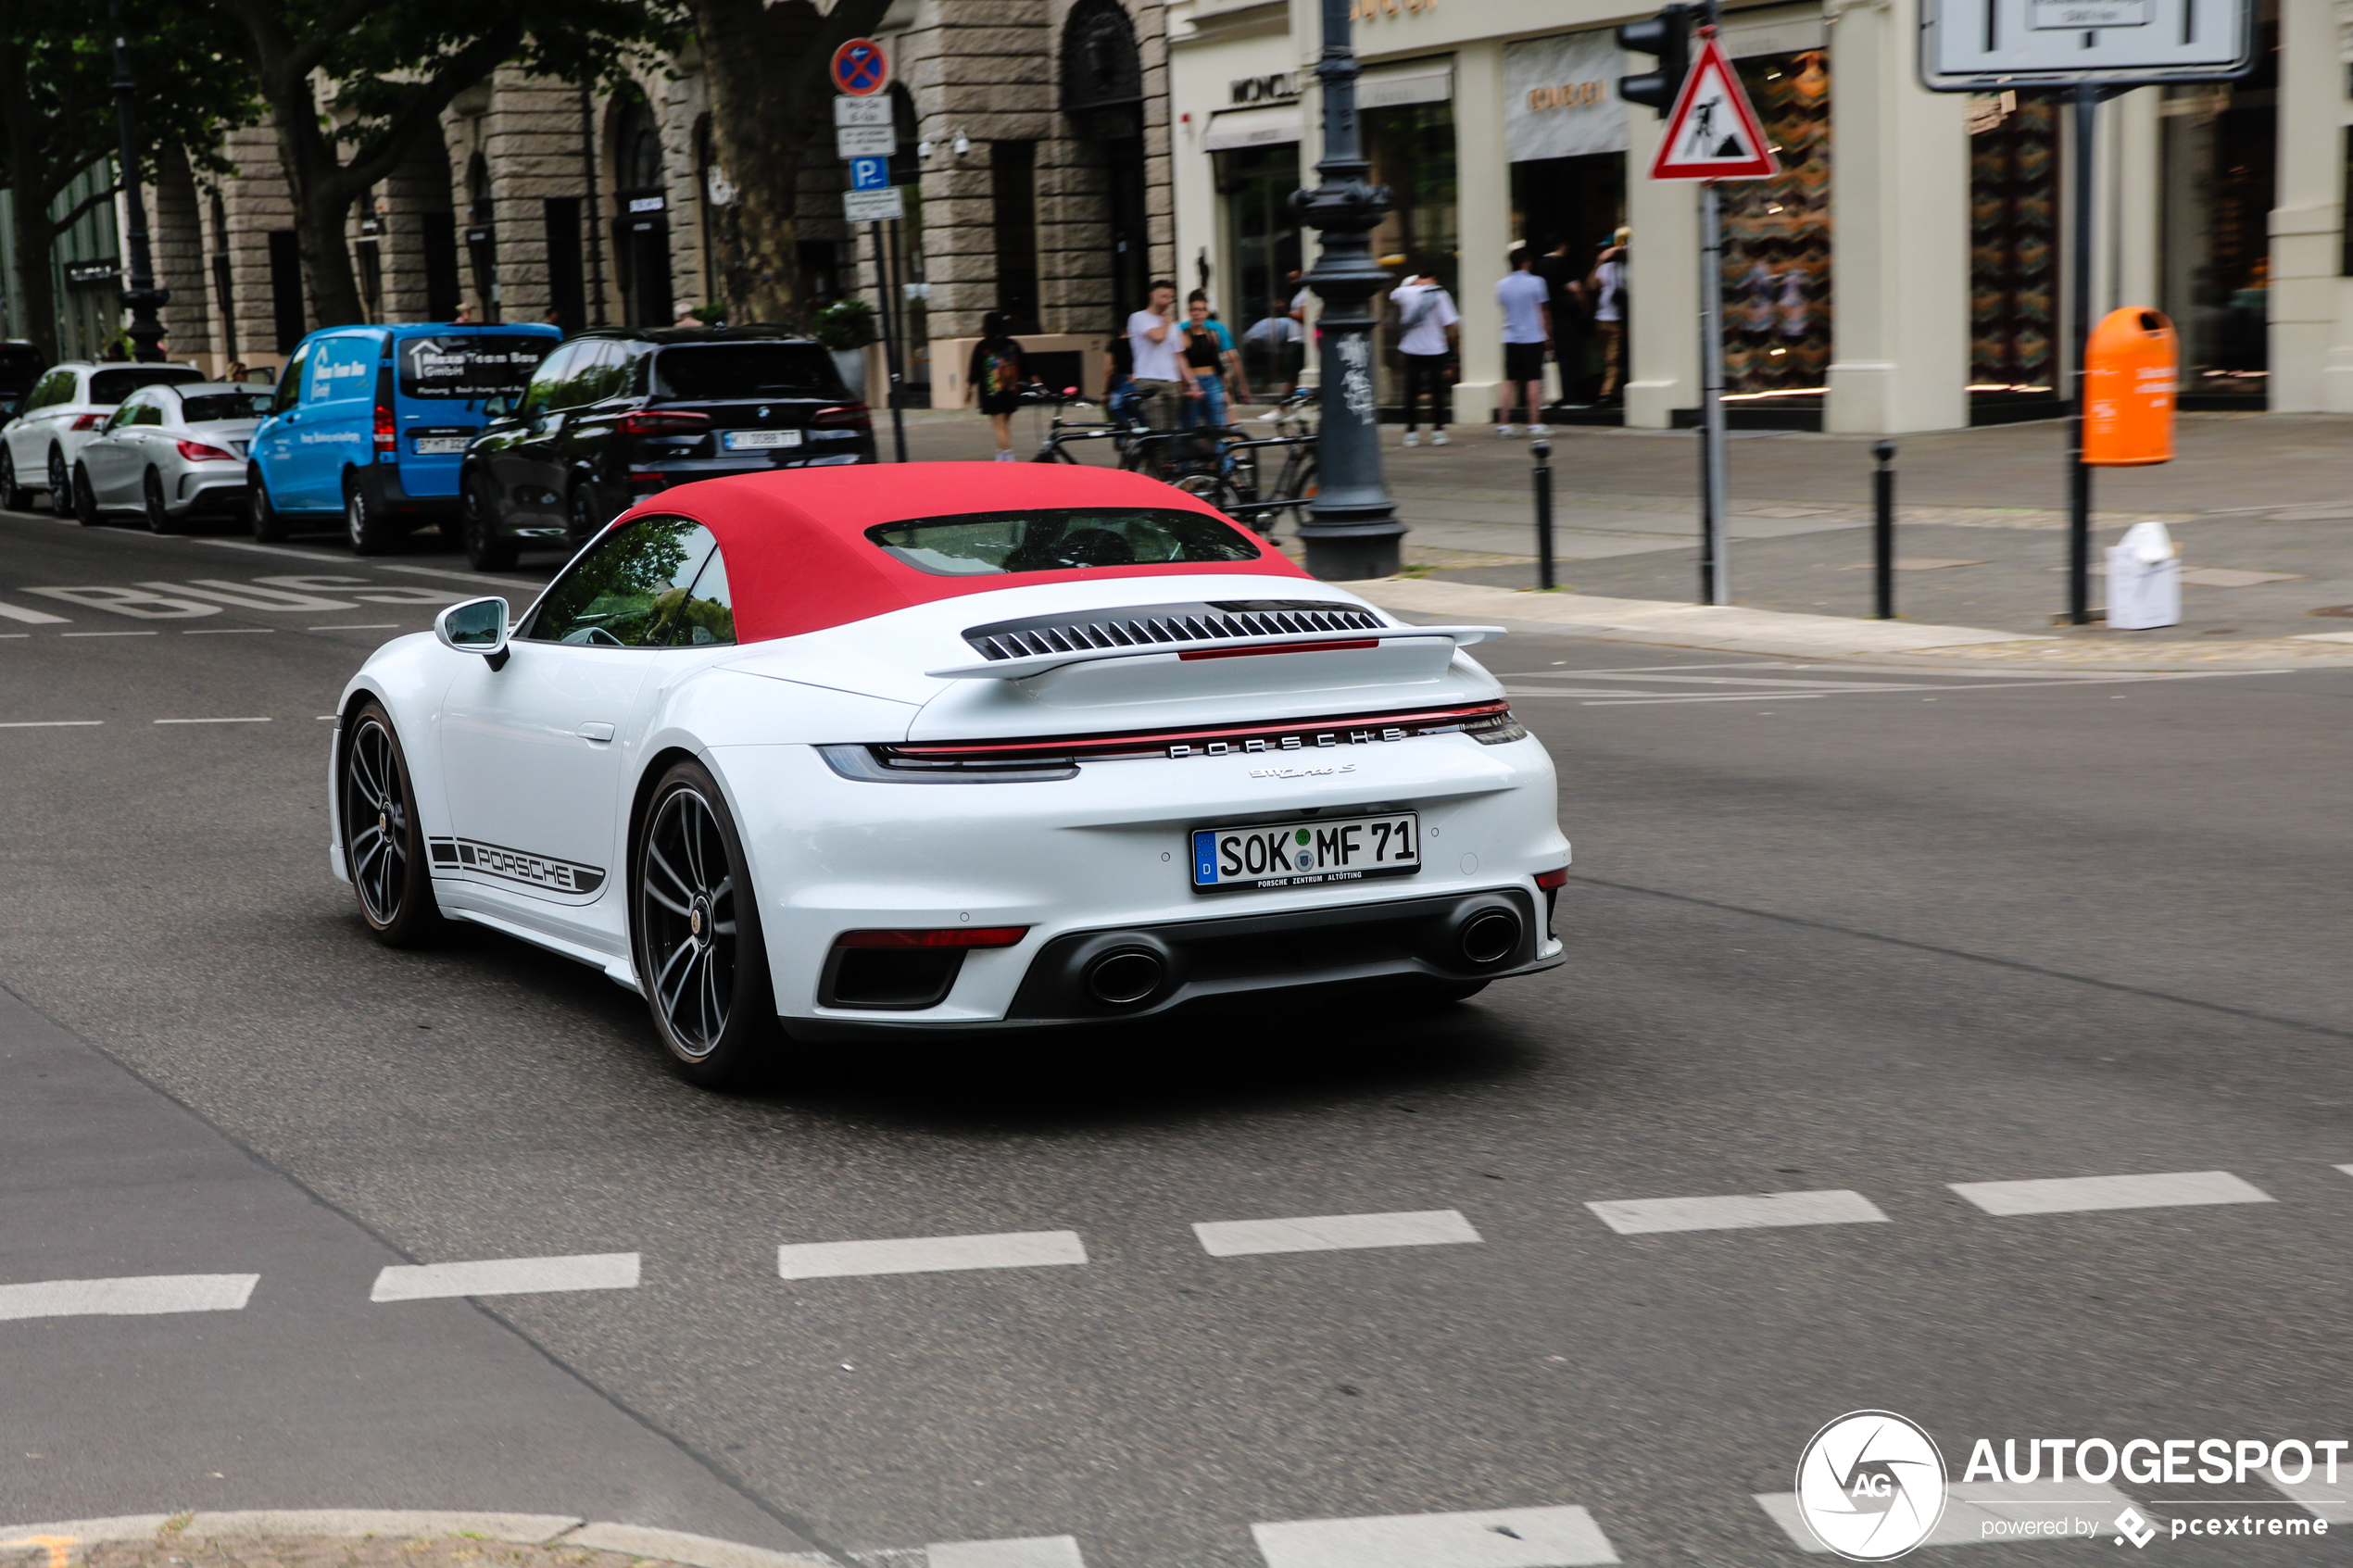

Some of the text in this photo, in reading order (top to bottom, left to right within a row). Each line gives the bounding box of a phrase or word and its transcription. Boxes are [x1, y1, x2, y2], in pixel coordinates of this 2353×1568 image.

[19, 576, 481, 619] BUS
[1170, 728, 1402, 759] PORSCHE
[477, 847, 572, 887] PORSCHE
[1202, 821, 1415, 876] D SOK MF 71
[1258, 871, 1362, 888] PORSCHE ZENTRUM ALTÖTTING
